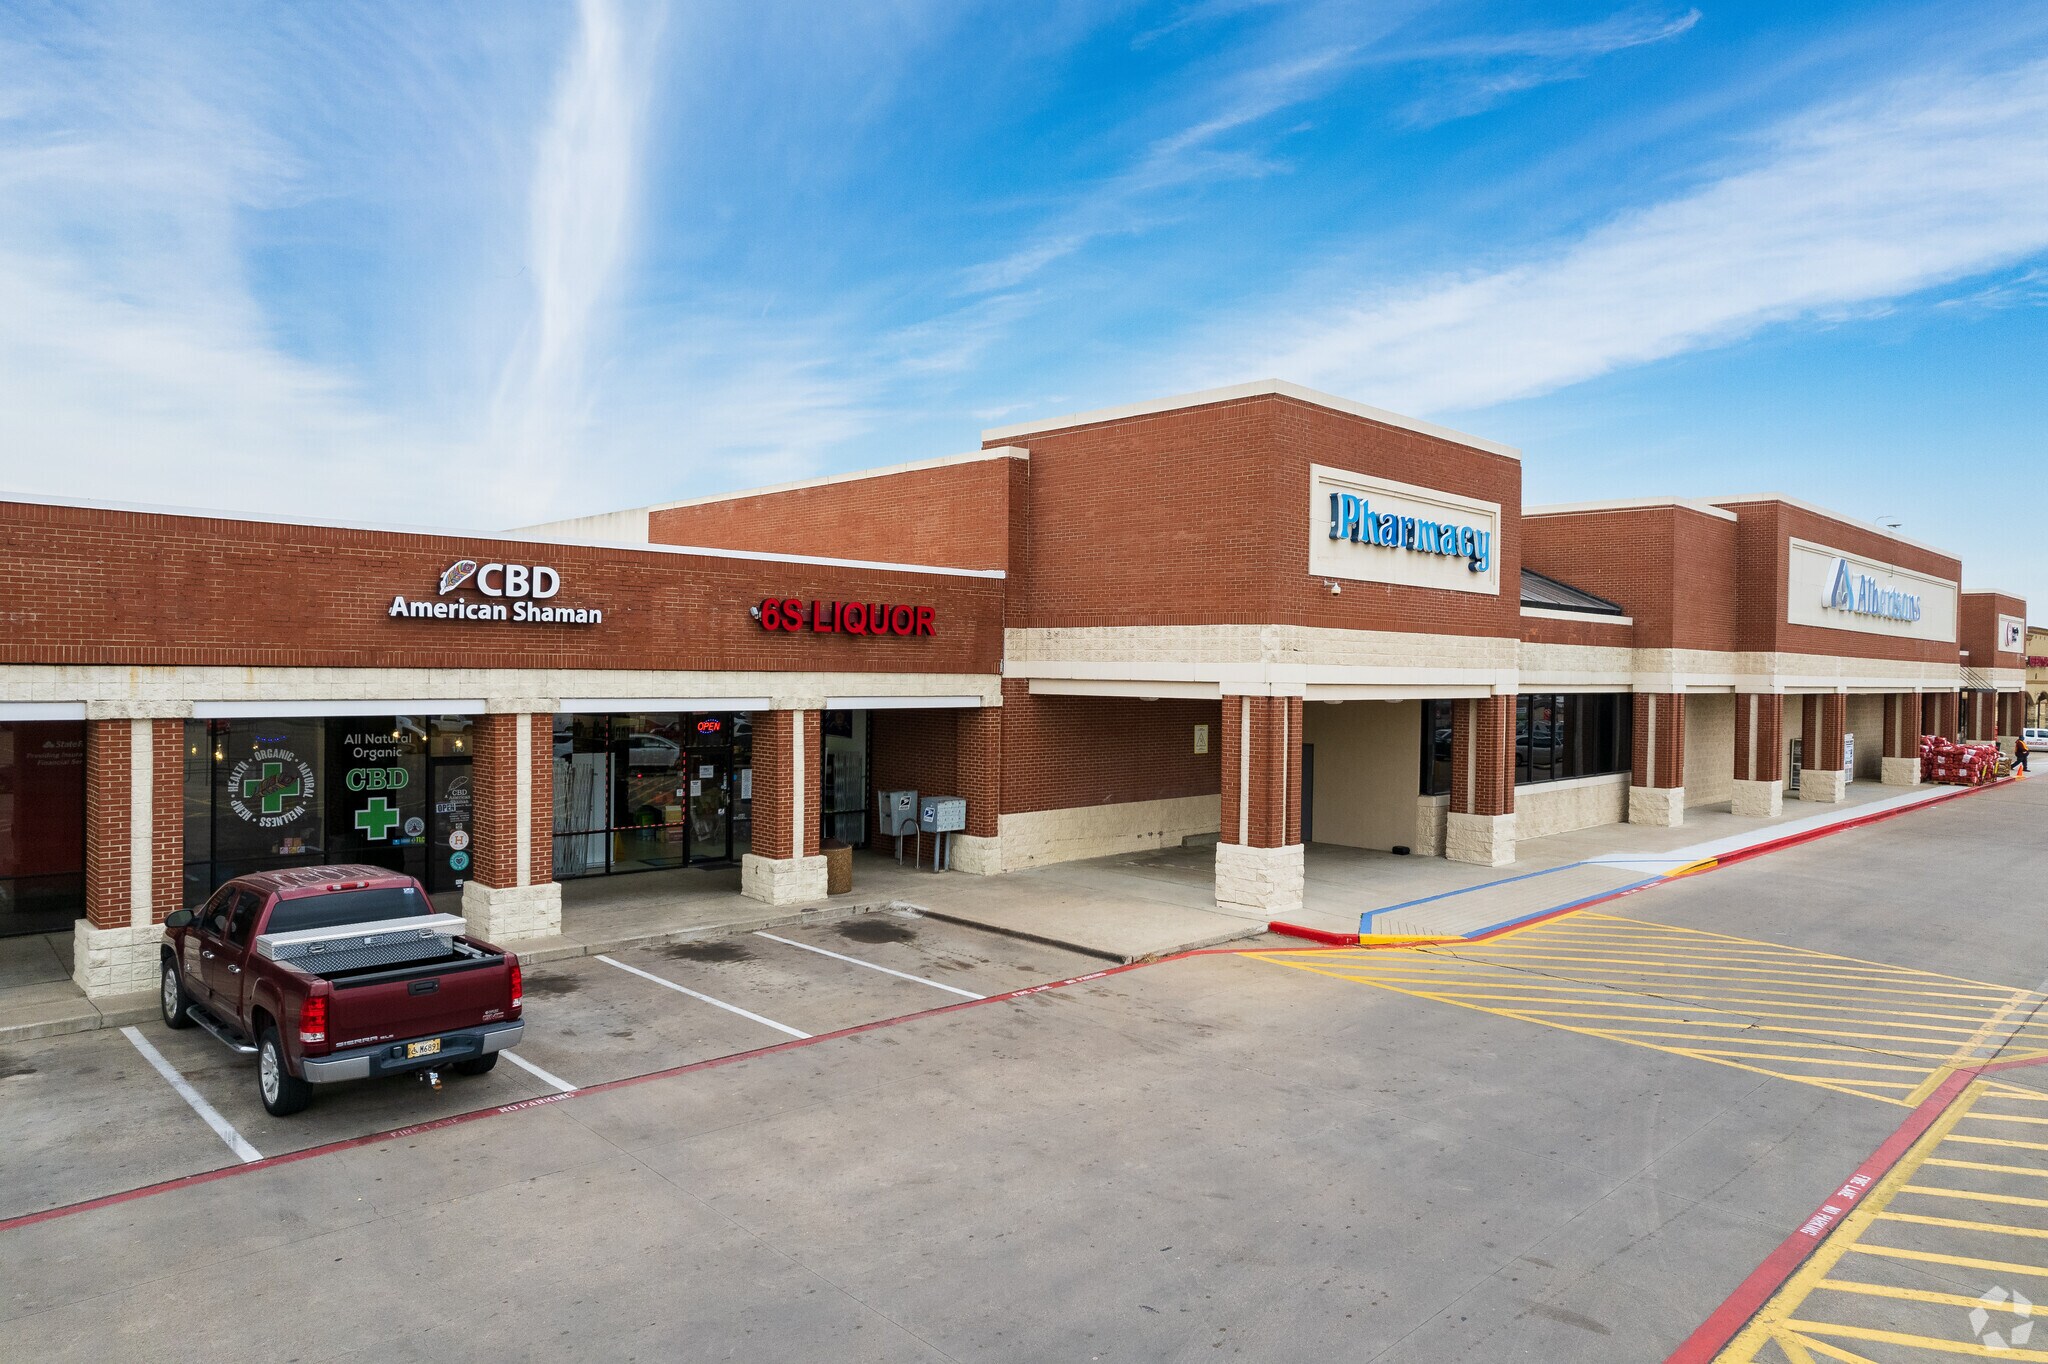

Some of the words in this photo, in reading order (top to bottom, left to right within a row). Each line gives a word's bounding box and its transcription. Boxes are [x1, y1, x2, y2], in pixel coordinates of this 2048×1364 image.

[1331, 493, 1490, 572] Pharmacy
[477, 563, 560, 599] CBD
[390, 596, 507, 620] American
[512, 601, 602, 624] Shaman
[761, 597, 803, 632] 6S
[812, 600, 937, 637] LIQUOR
[697, 721, 721, 731] OPEN
[344, 733, 362, 745] All
[365, 733, 412, 744] Natural
[254, 748, 295, 762] ORGANIC
[353, 747, 403, 761] Organic
[227, 761, 249, 793] HEALTH
[297, 762, 315, 798] NATURAL
[346, 767, 409, 791] CBD
[451, 789, 468, 797] CBD
[230, 800, 253, 821] HEMP
[259, 805, 306, 828] WELLNESS
[437, 803, 455, 812] OPEN
[454, 835, 464, 845] H
[335, 1035, 378, 1048] SIERRA
[498, 1104, 517, 1113] NO
[519, 1092, 575, 1110] PARKING
[1822, 1204, 1842, 1215] NO
[1800, 1212, 1834, 1237] PARKING
